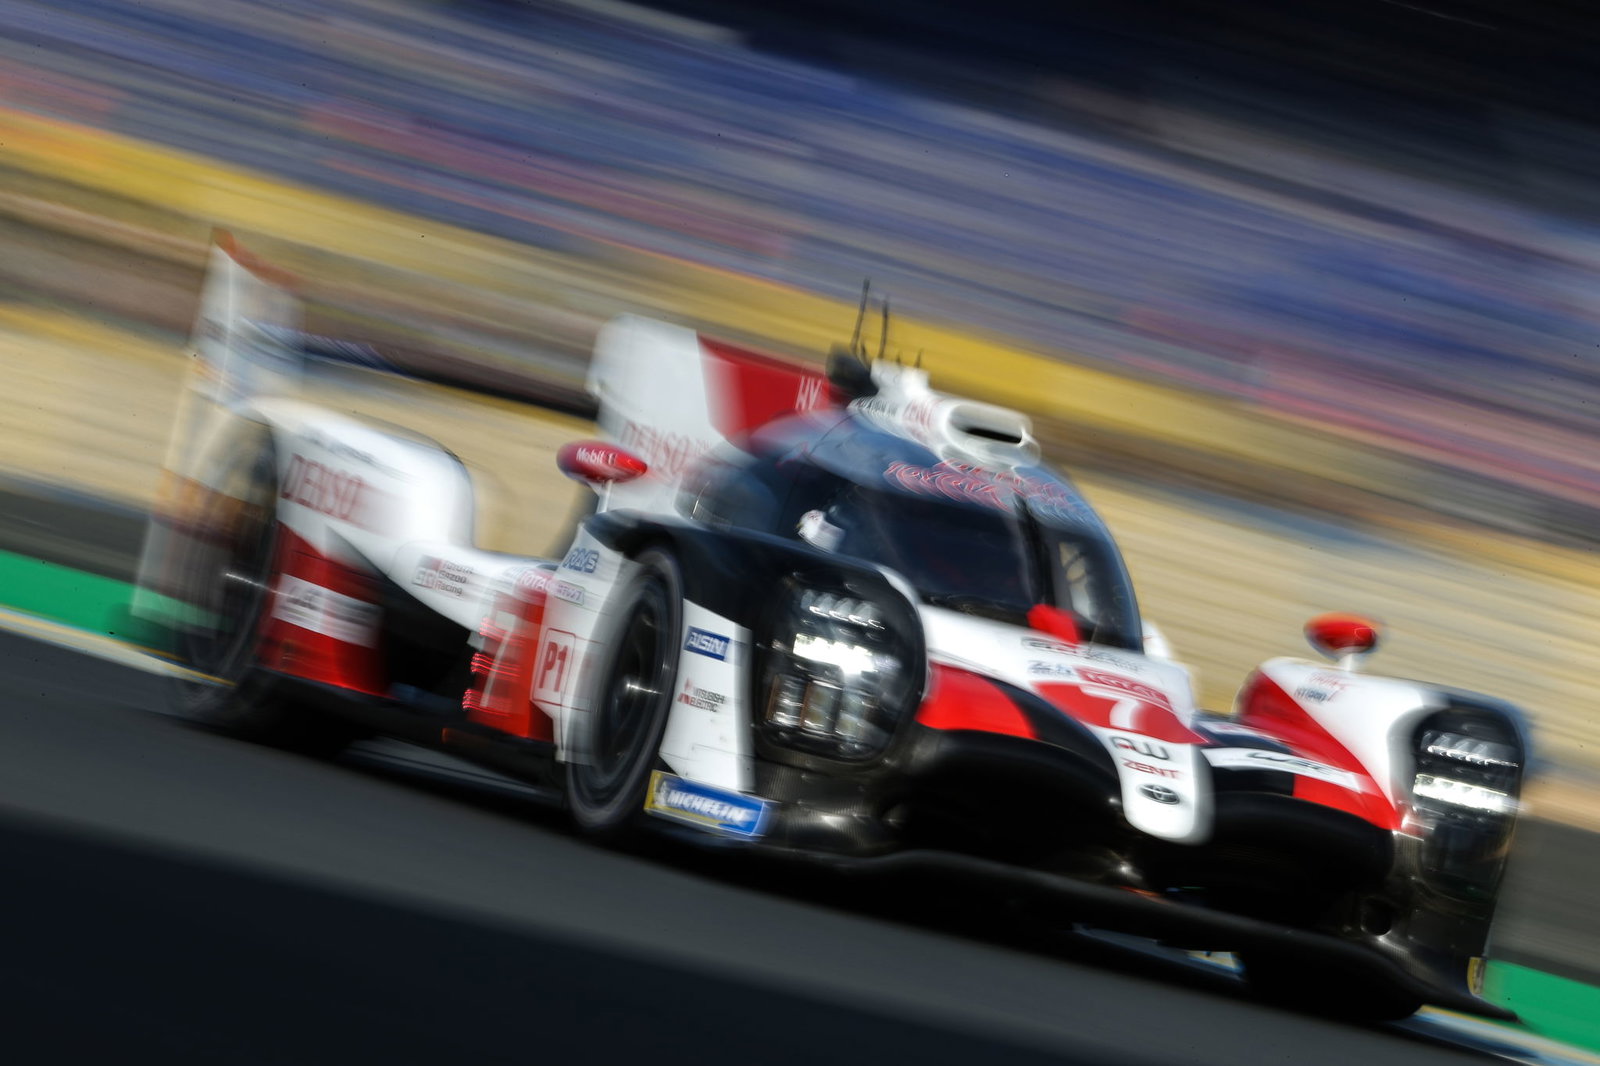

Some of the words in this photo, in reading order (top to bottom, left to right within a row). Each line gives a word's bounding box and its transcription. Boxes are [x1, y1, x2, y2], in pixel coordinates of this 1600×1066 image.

[576, 448, 606, 464] Mobil
[280, 453, 368, 520] DENSO
[687, 632, 726, 655] AISIN
[539, 641, 568, 692] P1
[1078, 684, 1140, 730] 7
[1122, 759, 1181, 779] ZENT
[668, 791, 750, 821] MICHELIN
